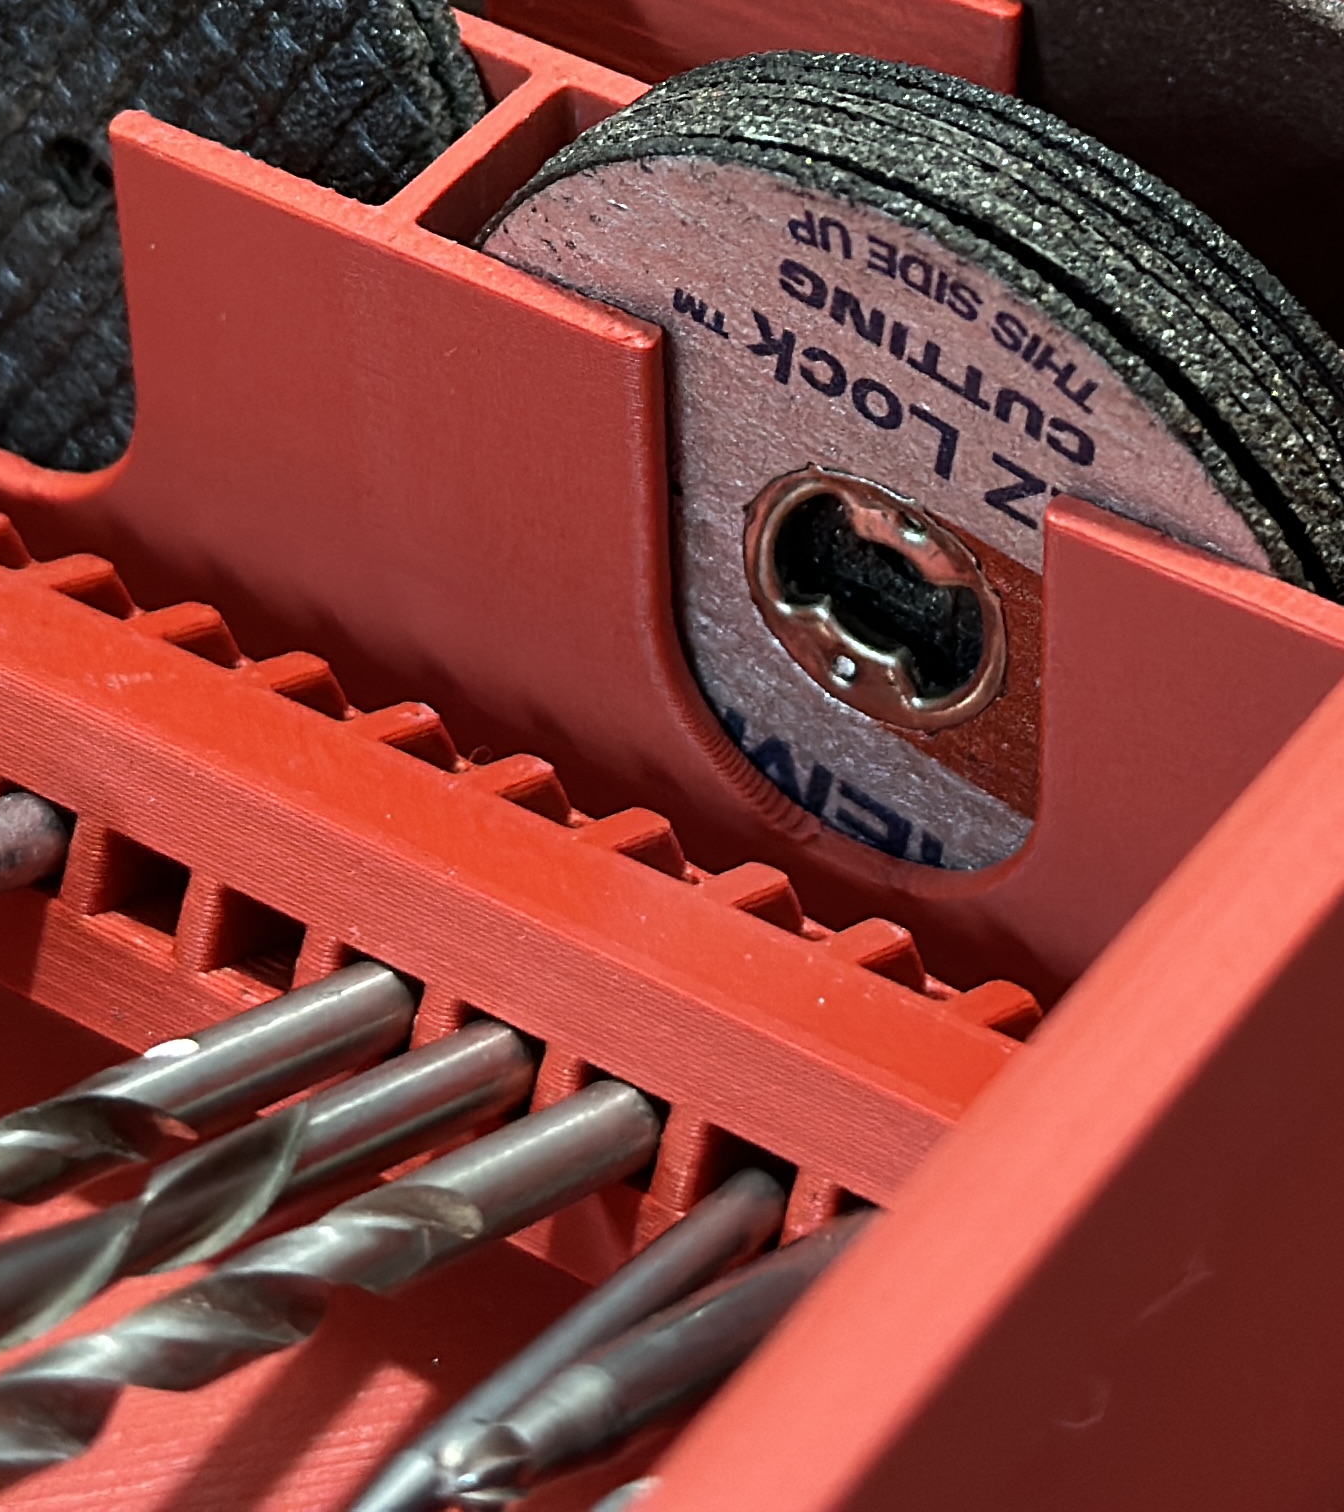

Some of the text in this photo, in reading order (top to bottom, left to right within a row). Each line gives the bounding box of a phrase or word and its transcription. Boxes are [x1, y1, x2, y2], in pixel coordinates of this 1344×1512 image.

[779, 260, 1096, 467] CUTTING
[789, 209, 1099, 415] THIS SIDE UP
[985, 452, 1062, 530] Z
